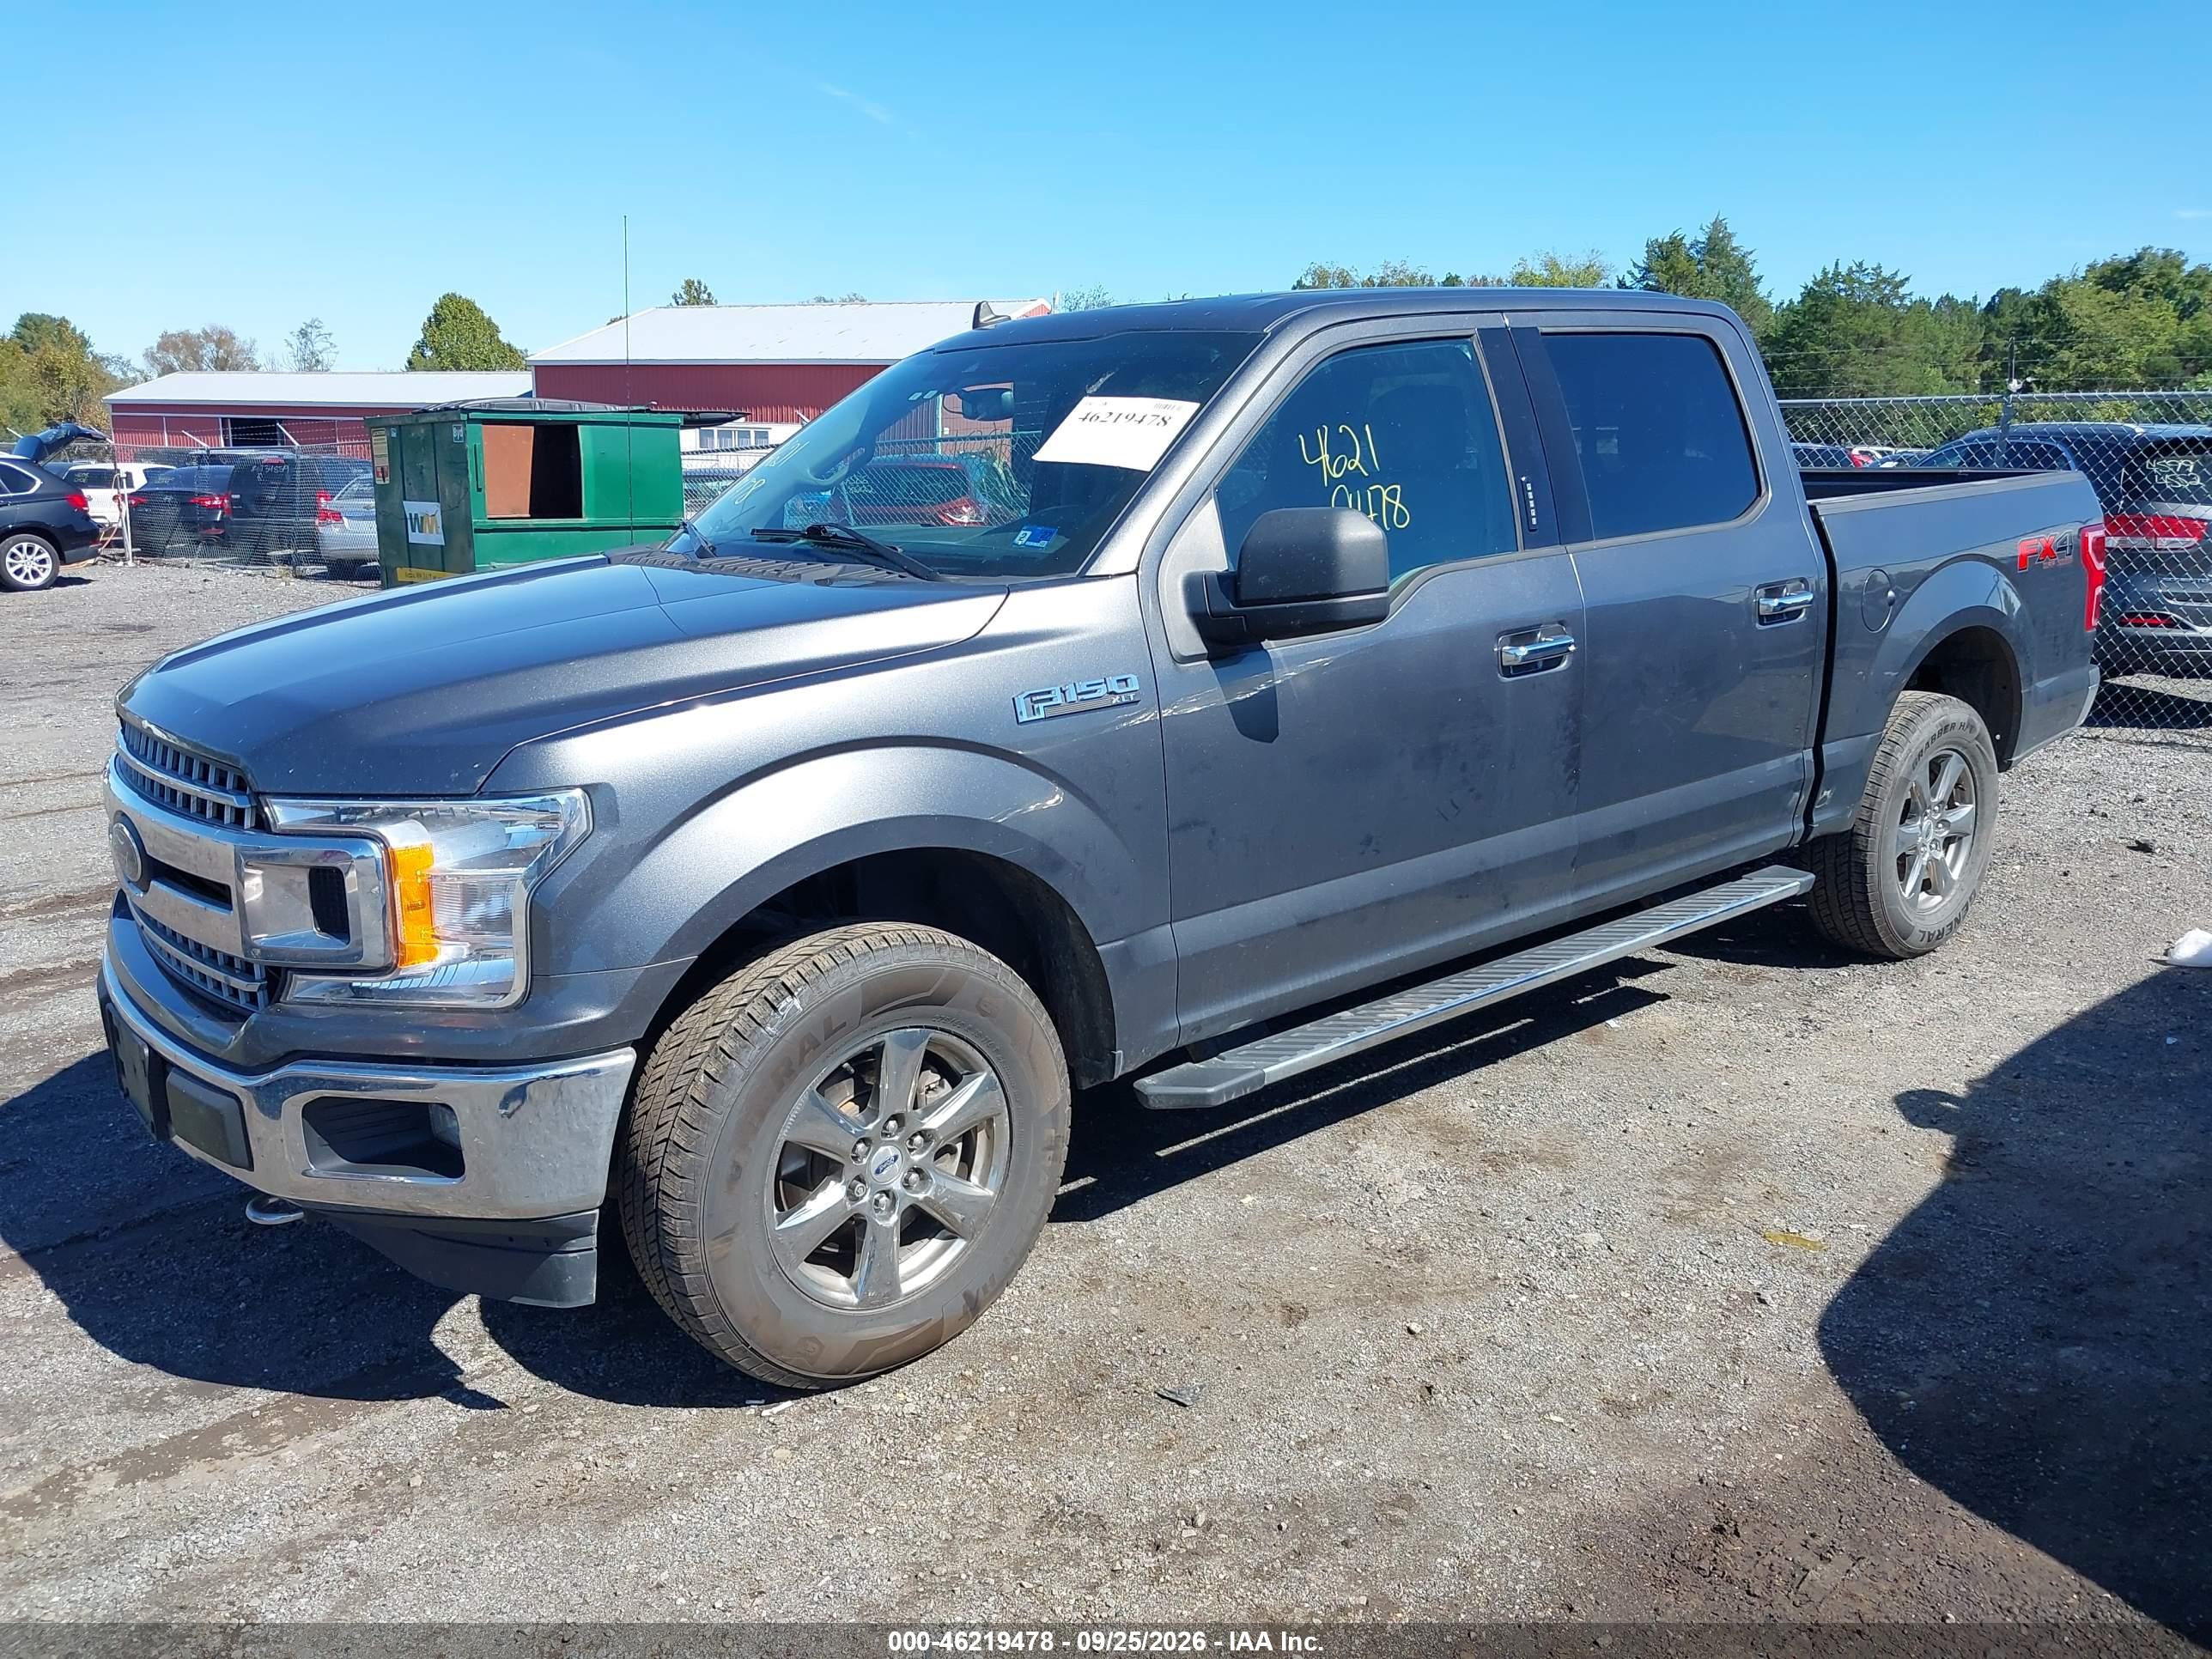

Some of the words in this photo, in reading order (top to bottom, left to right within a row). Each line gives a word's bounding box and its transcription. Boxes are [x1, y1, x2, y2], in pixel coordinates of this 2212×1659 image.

[1078, 411, 1172, 427] 46219478
[1297, 423, 1381, 488] 4621
[2017, 529, 2074, 573] FX4
[1111, 693, 1136, 704] XLT
[1911, 721, 1957, 771] GRABBER
[1918, 888, 1977, 943] GENERAL
